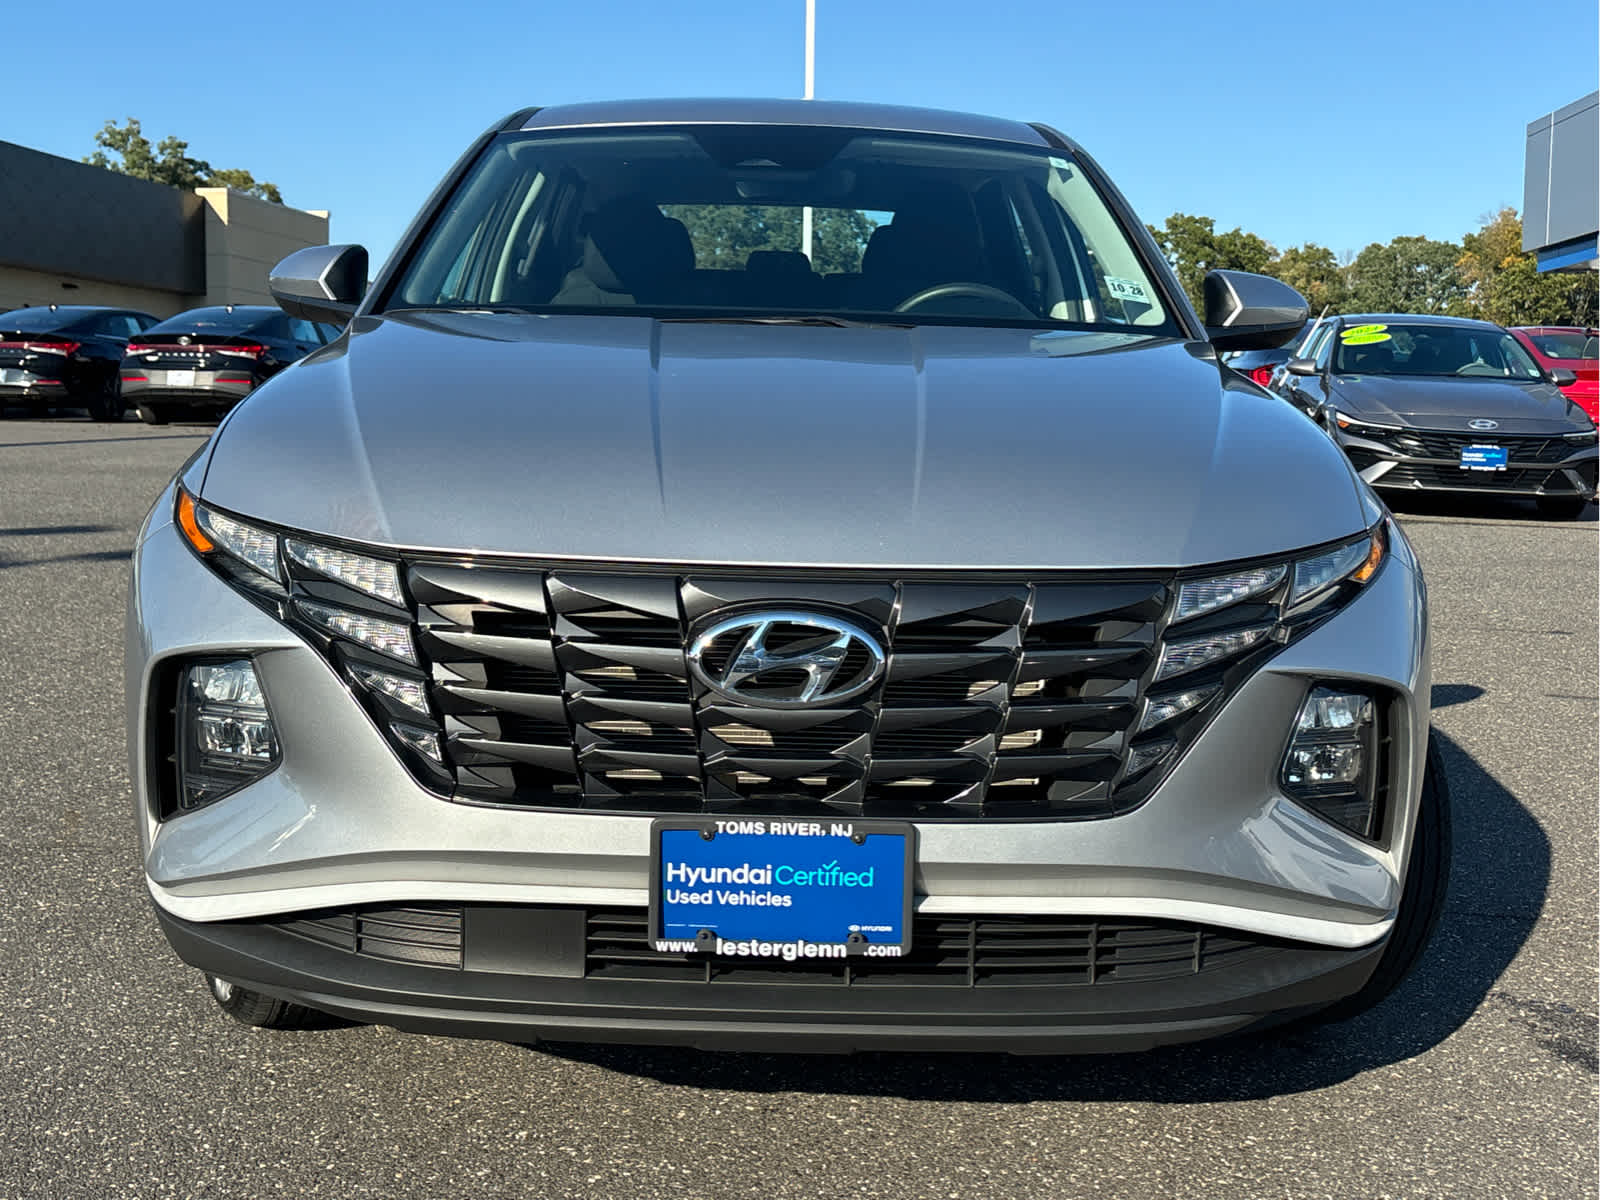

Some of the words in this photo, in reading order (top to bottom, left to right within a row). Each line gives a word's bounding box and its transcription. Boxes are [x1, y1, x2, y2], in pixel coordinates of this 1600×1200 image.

[1111, 282, 1125, 292] 10
[715, 821, 766, 836] TOMS
[770, 822, 827, 837] RIVER,
[830, 823, 853, 837] NJ
[667, 862, 773, 888] Hyundai
[775, 863, 875, 888] Certified
[666, 889, 713, 905] Used
[716, 890, 793, 907] Vehicles
[655, 940, 699, 953] www.
[715, 937, 848, 961] lesterglenn
[863, 945, 902, 958] .com
